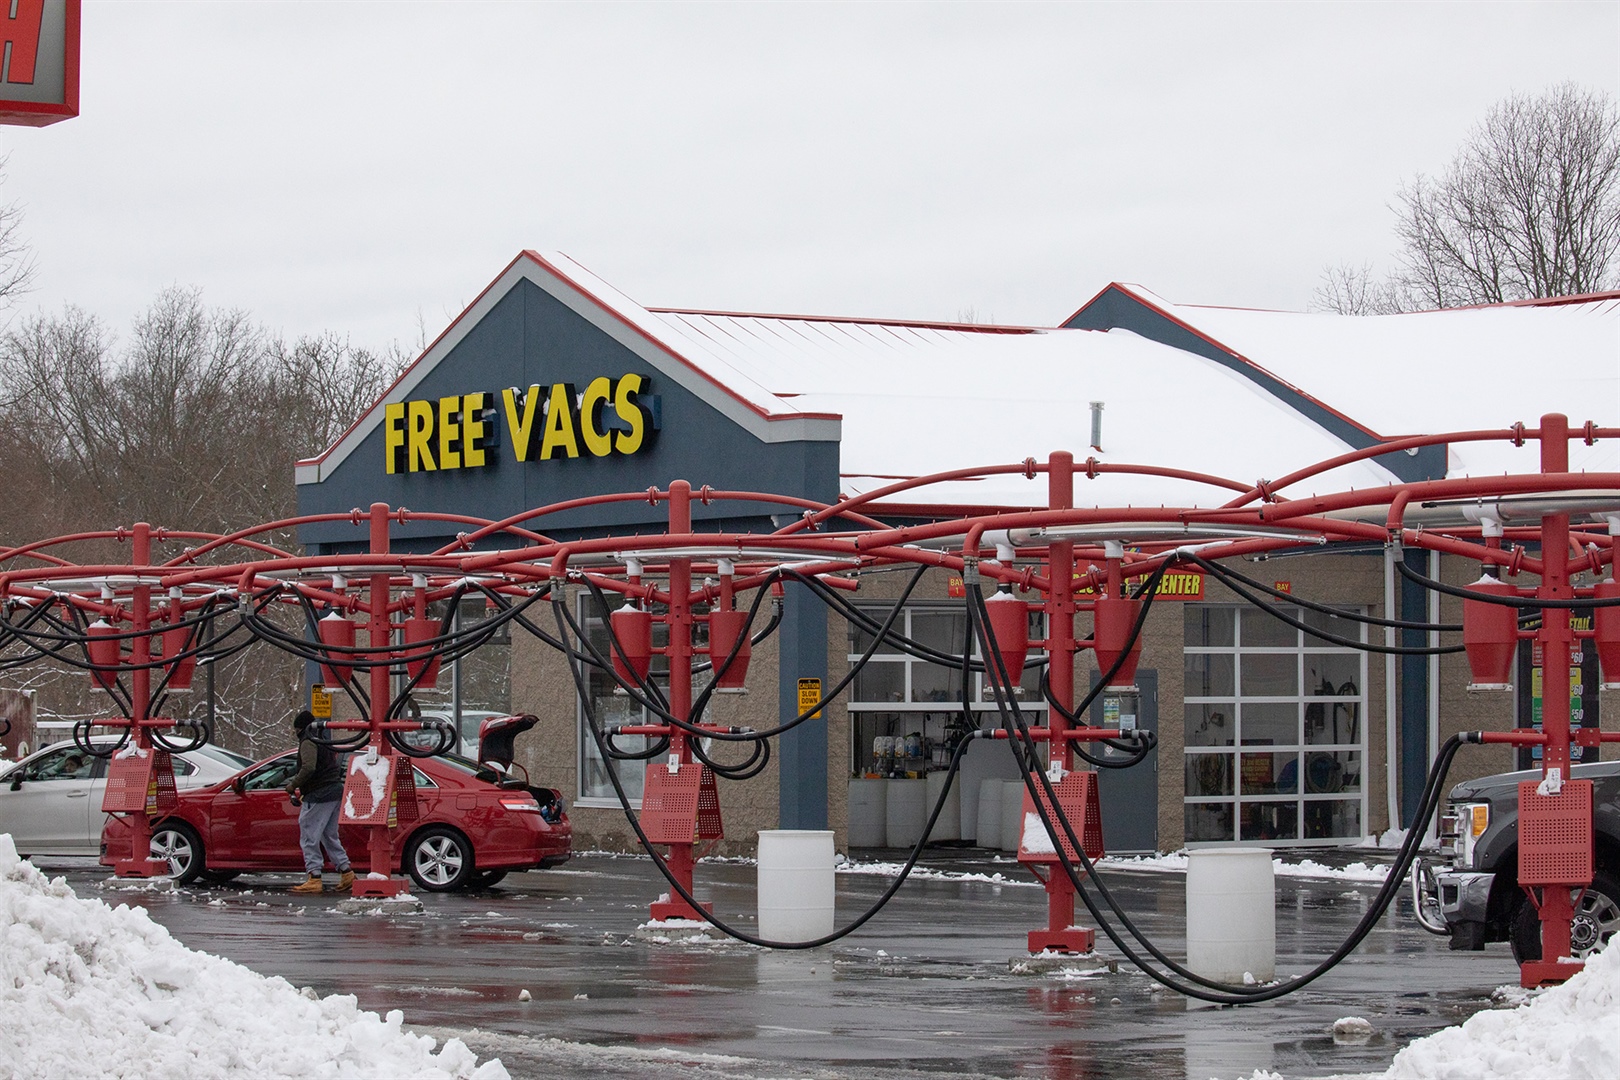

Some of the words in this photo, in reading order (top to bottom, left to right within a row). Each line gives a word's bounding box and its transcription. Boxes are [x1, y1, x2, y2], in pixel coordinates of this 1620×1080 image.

[385, 393, 487, 475] FREE
[502, 373, 645, 463] VACS
[1276, 583, 1289, 591] BAY
[1571, 652, 1584, 663] $60
[1571, 709, 1584, 720] $50
